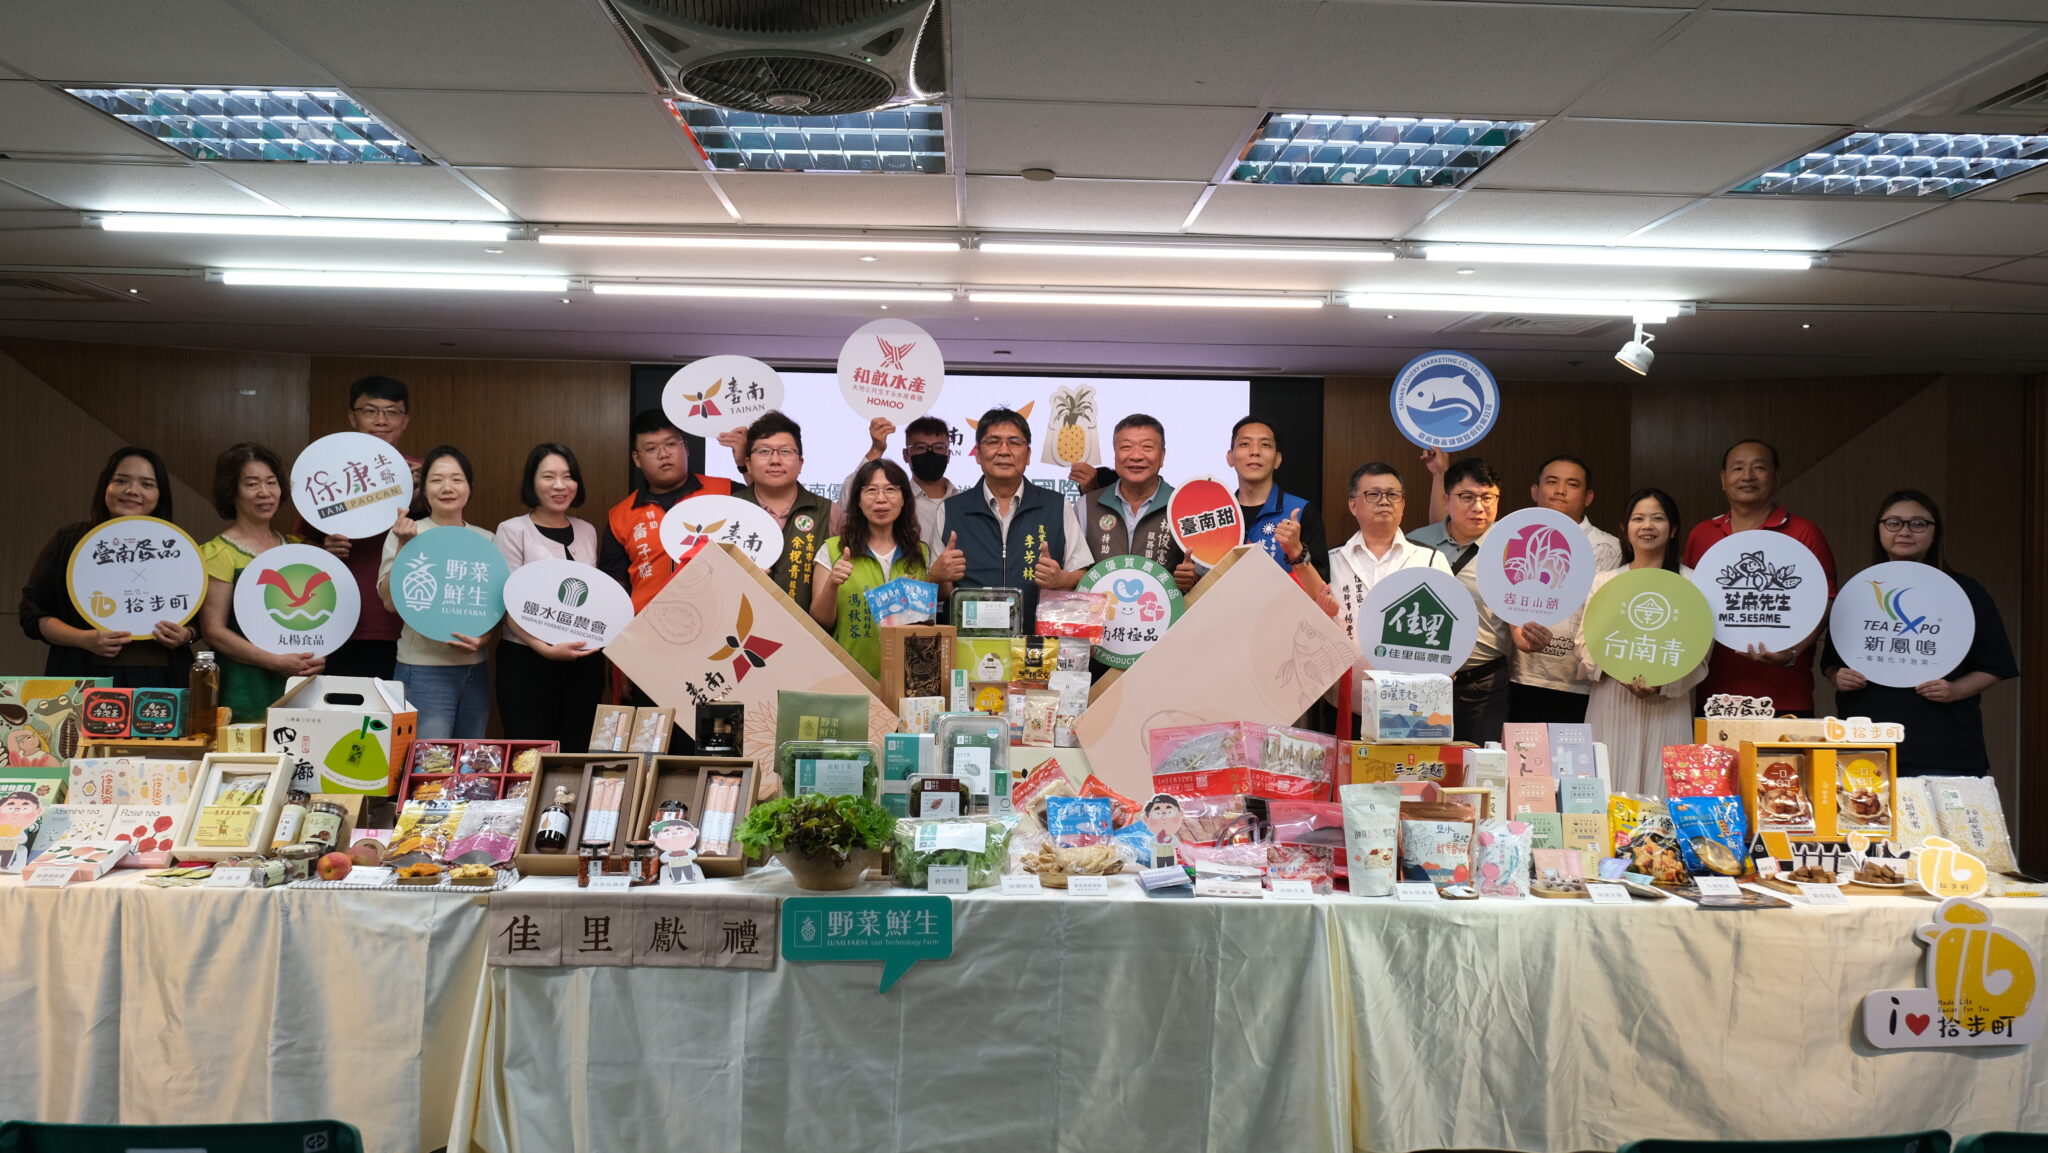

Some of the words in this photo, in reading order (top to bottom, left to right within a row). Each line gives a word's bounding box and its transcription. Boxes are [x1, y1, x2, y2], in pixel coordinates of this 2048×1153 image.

[1402, 366, 1420, 388] FISHERY
[1420, 357, 1457, 369] MARKETING
[724, 376, 764, 405] 臺南
[730, 404, 765, 415] TAINAN
[866, 397, 904, 410] HOMOO
[320, 503, 346, 517] IAM
[350, 488, 400, 508] PAOCAN
[1180, 506, 1235, 536] 臺南甜
[1022, 534, 1036, 581] 李芳林
[445, 559, 490, 583] 野菜
[124, 594, 189, 613] 拾步町
[442, 583, 488, 607] 鮮生
[1724, 592, 1791, 611] 芝麻先生
[522, 601, 608, 635] 鹽水區農會
[1388, 602, 1445, 646] 佳里
[1864, 620, 1888, 631] TEA
[1893, 616, 1940, 635] EXPO
[277, 634, 324, 646] 丸楊食品
[570, 628, 604, 642] ASSOCIATION
[1864, 635, 1937, 655] 新鳳鳴
[1388, 648, 1453, 665] 佳里區農會
[1604, 630, 1685, 667] 台南青
[1852, 725, 1902, 740] 拾步町
[1771, 769, 1787, 778] 一口
[120, 809, 143, 817] Rose
[146, 809, 160, 817] tea
[827, 910, 939, 937] 野菜鮮生
[498, 914, 760, 955] 佳里獻禮
[847, 939, 868, 947] FARM
[885, 939, 921, 948] Technology
[1937, 1015, 2016, 1038] 拾步町
